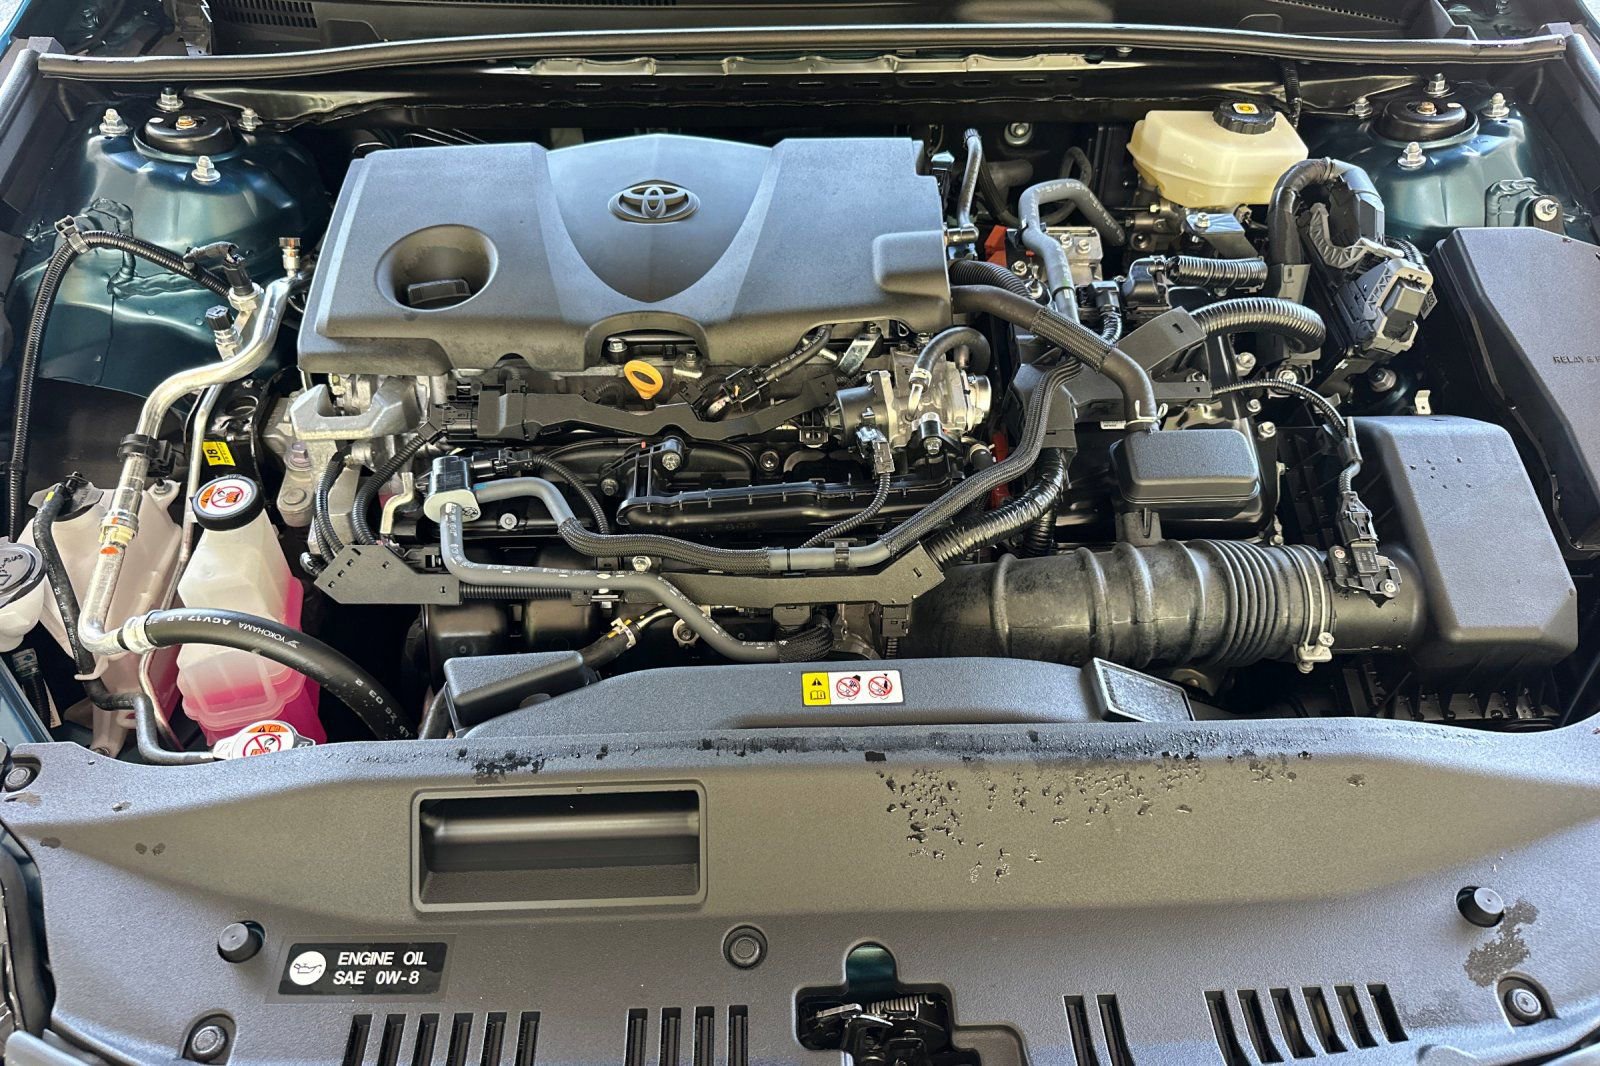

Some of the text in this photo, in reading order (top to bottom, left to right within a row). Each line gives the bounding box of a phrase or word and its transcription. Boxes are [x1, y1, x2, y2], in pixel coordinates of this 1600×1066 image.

[187, 615, 232, 626] ACV17
[238, 621, 287, 643] YOKOHAMA
[337, 951, 428, 966] ENGINE OIL
[333, 970, 420, 985] SAE 0W-8
